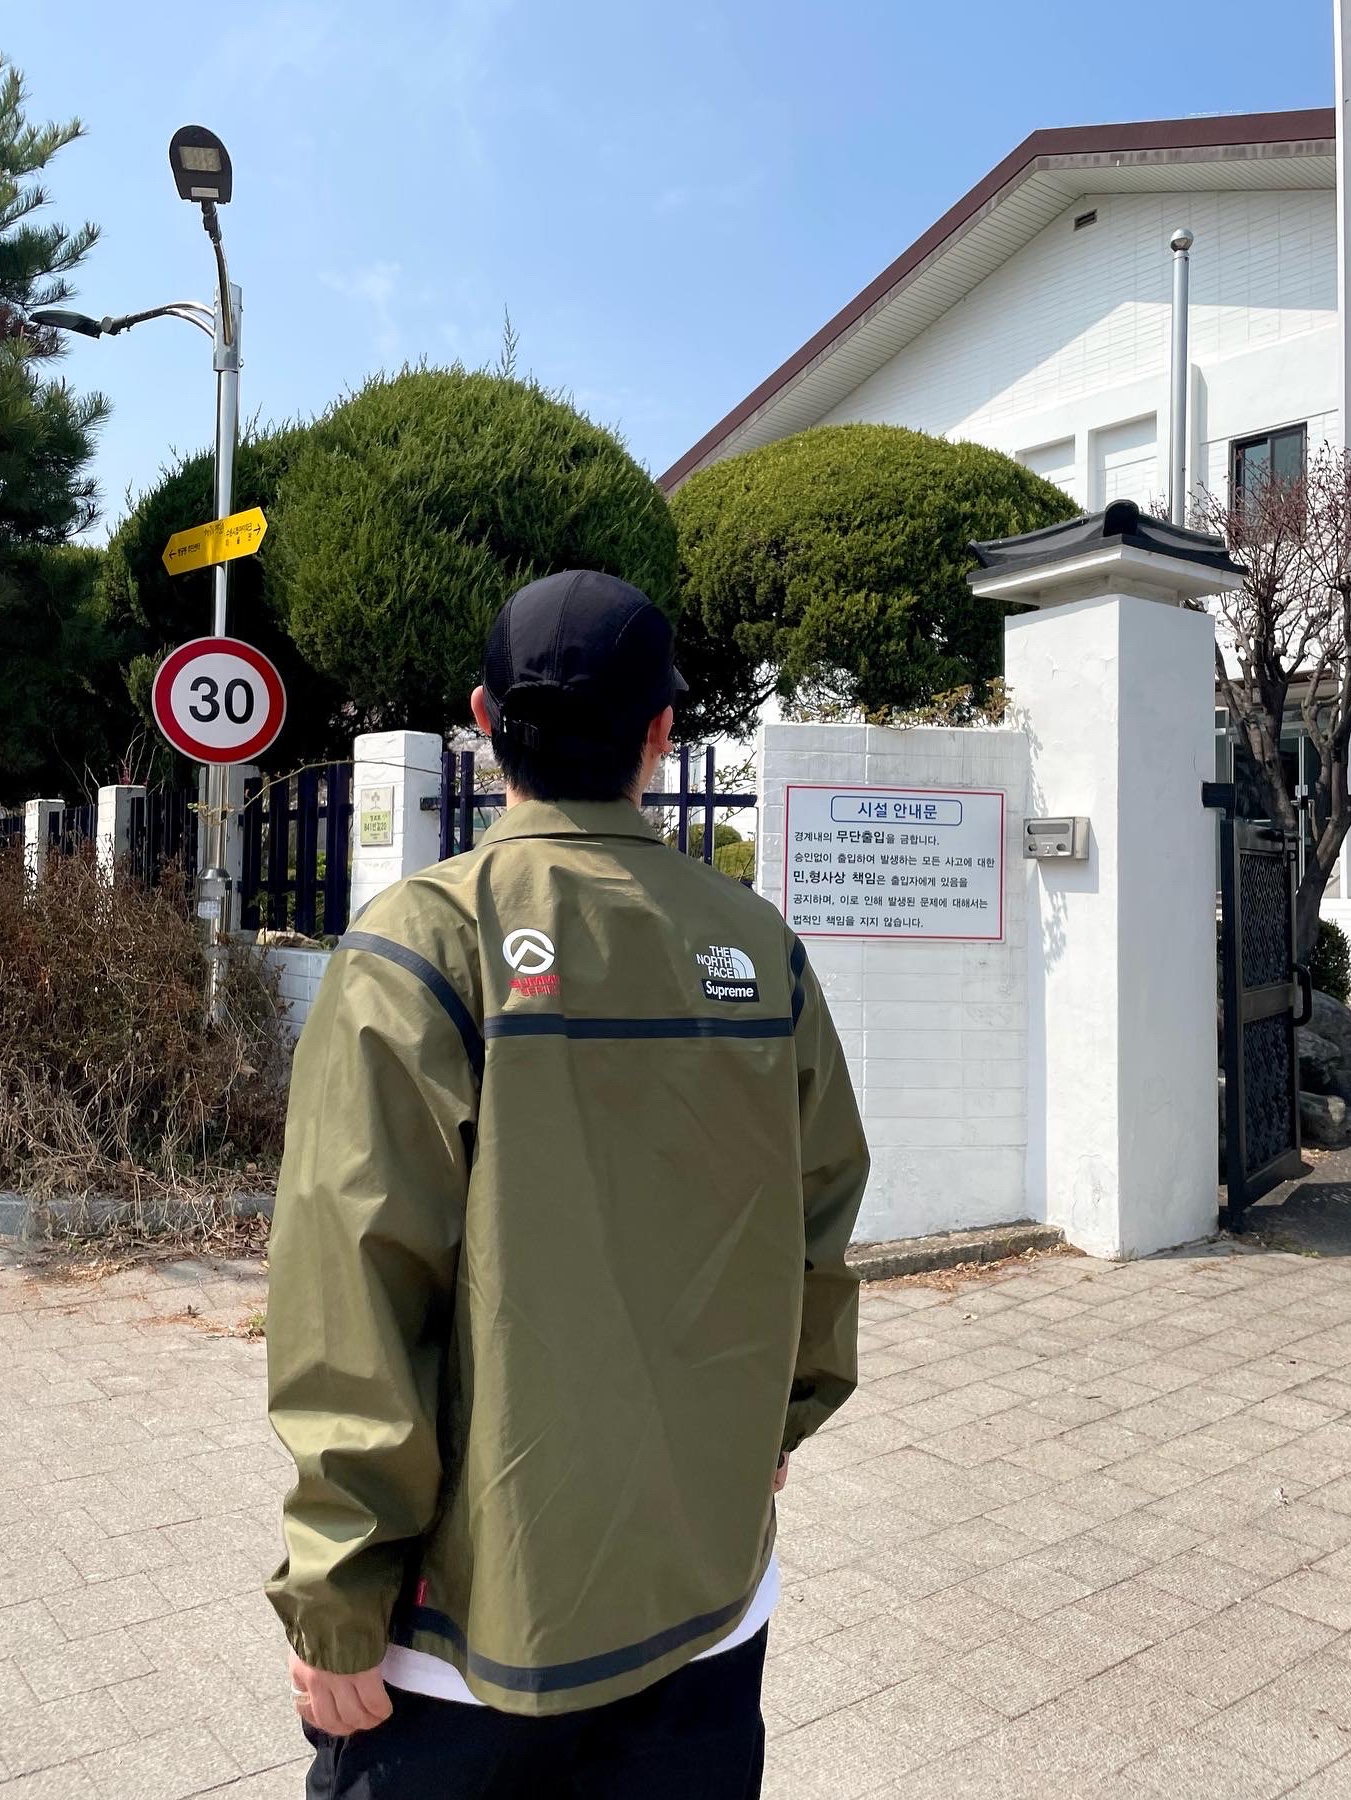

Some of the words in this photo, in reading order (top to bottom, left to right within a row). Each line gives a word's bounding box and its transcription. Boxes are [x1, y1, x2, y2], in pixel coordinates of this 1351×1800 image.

[189, 676, 254, 724] 30
[858, 802, 887, 818] 시설
[894, 803, 937, 819] 안내문
[795, 832, 832, 843] 경계내의
[836, 831, 895, 844] 무단출입을
[900, 835, 939, 845] 금합니다.
[794, 852, 831, 863] 승인없이
[838, 853, 874, 864] 출입하여
[881, 855, 917, 865] 발생하는
[922, 856, 940, 866] 모든
[945, 857, 972, 867] 사고에
[978, 858, 995, 868] 대한
[794, 870, 846, 884] 민,형사상
[852, 872, 885, 885] 책임은
[891, 876, 935, 887] 출입자에게
[941, 877, 967, 887] 있음을
[793, 894, 834, 905] 공지하며,
[840, 896, 859, 905] 이로
[864, 896, 882, 906] 인해
[888, 897, 915, 907] 발생된
[920, 897, 947, 907] 문제에
[953, 898, 988, 908] 대해서는
[793, 915, 820, 925] 법적인
[826, 916, 855, 926] 책임을
[860, 917, 878, 927] 지지
[884, 917, 923, 928] 않습니다.
[709, 945, 731, 958] THE
[696, 953, 732, 968] NORTH
[707, 966, 735, 979] FACE
[509, 974, 560, 988] SUMMI
[705, 980, 754, 1000] Supreme
